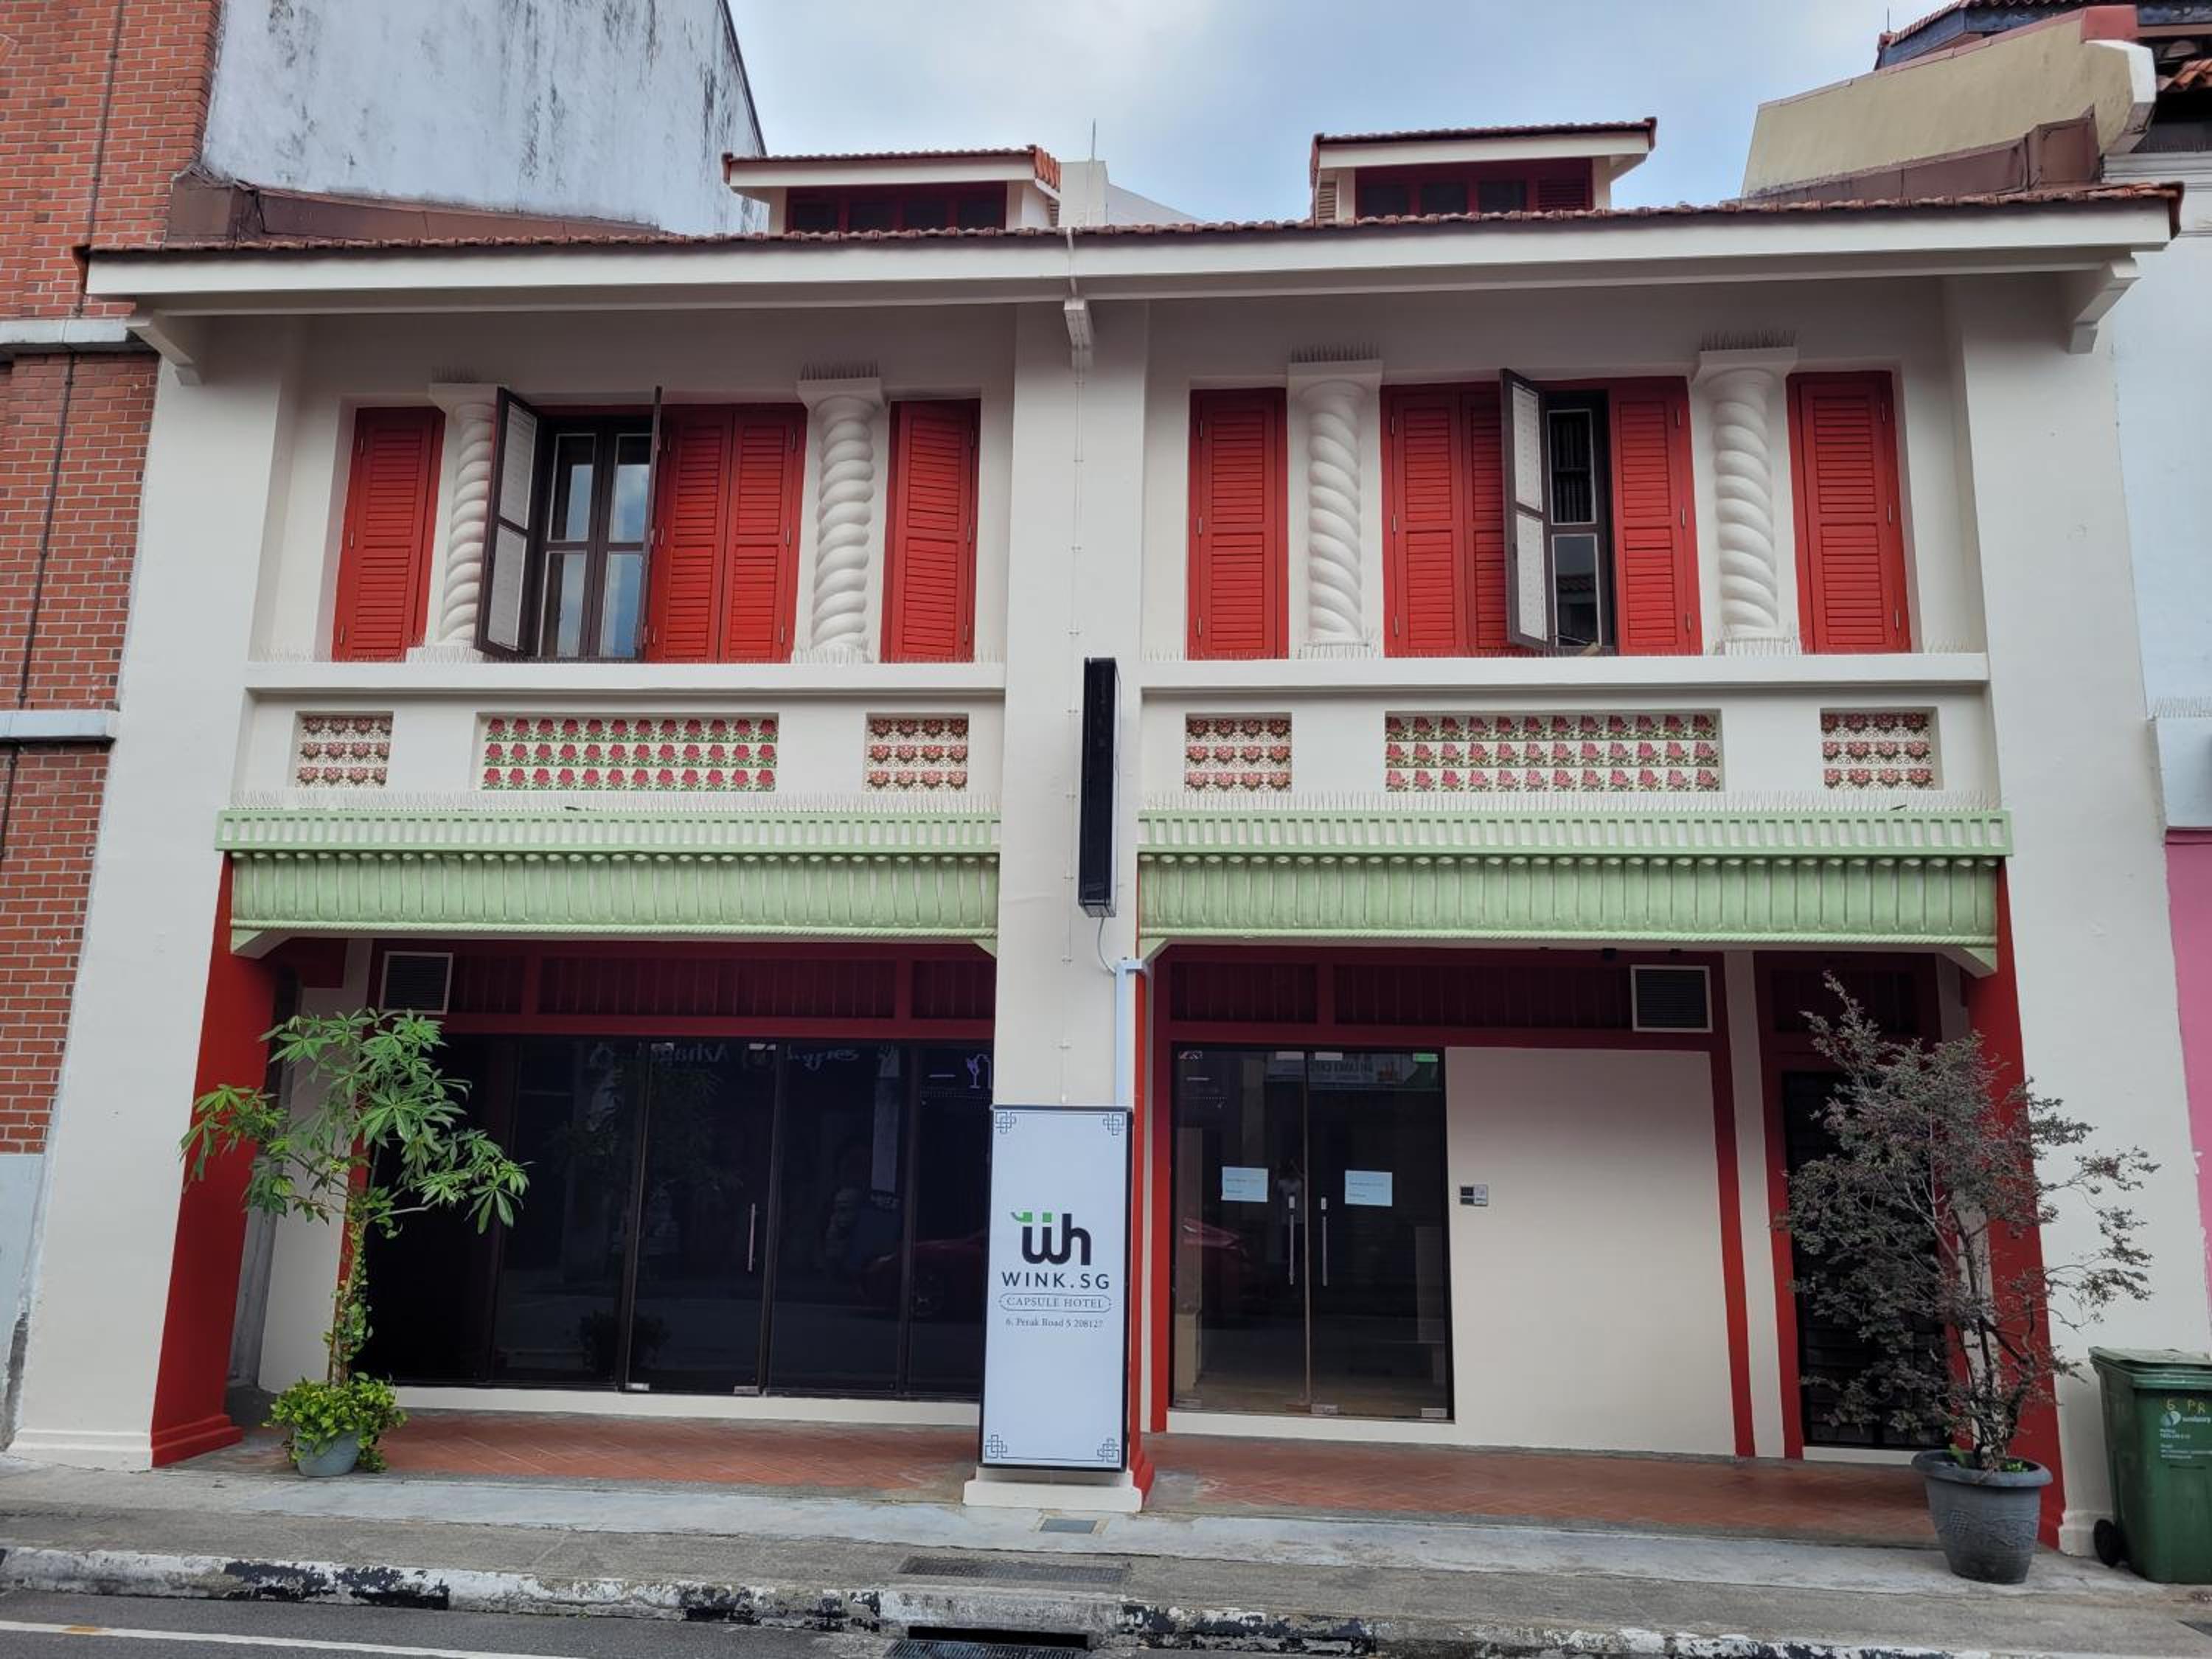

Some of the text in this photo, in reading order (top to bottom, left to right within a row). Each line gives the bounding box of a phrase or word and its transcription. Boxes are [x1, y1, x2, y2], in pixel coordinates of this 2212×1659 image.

[1001, 1272, 1110, 1290] WINK.SG
[1006, 1297, 1103, 1309] CAPSULE HOTEL
[1016, 1316, 1039, 1326] Perak
[1042, 1318, 1063, 1327] Road
